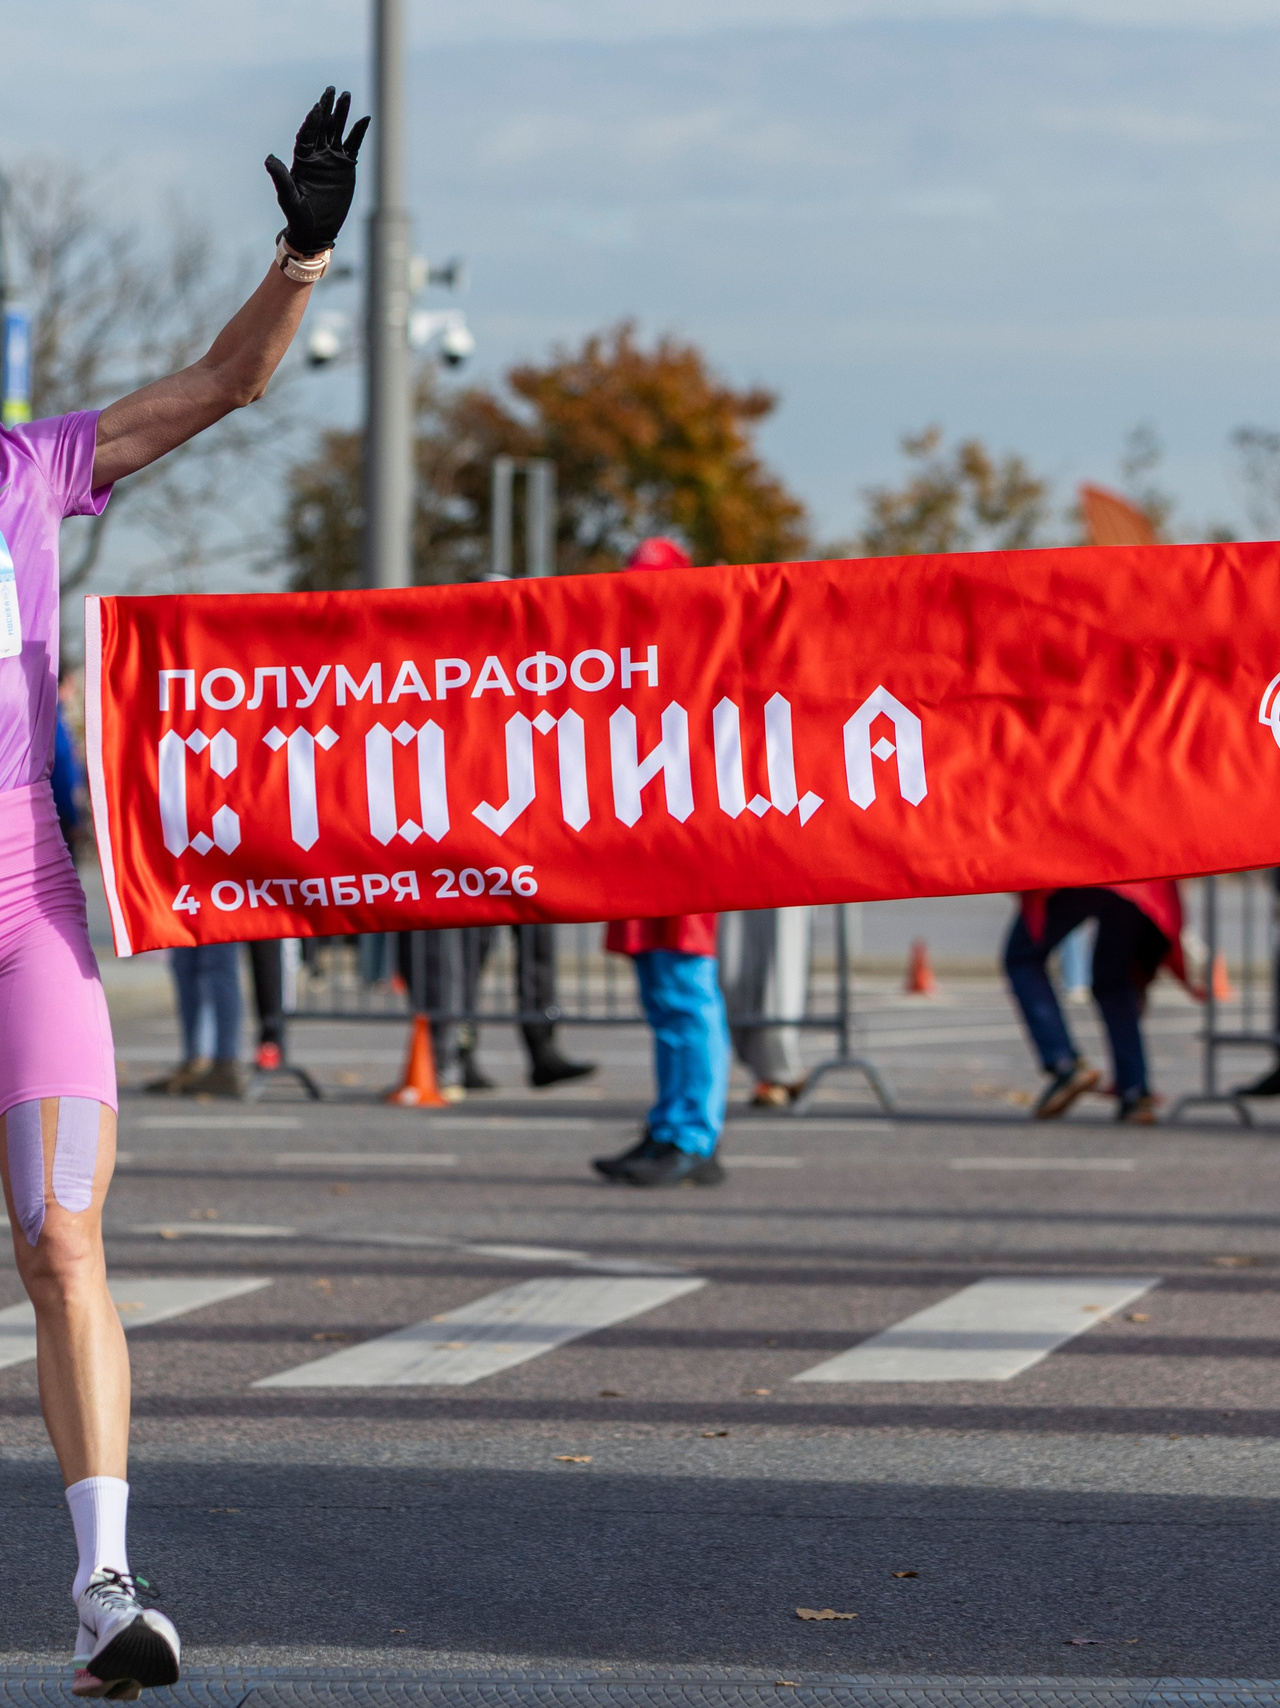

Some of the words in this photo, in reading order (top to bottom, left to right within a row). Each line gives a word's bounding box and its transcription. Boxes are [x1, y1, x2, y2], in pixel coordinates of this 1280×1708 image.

[158, 644, 660, 713] ПОЛУМАРАФОН
[158, 684, 928, 859] СТОЛИЦА
[171, 884, 201, 915] 4
[210, 870, 421, 912] ОКТЯБРЯ
[431, 864, 539, 899] 2026
